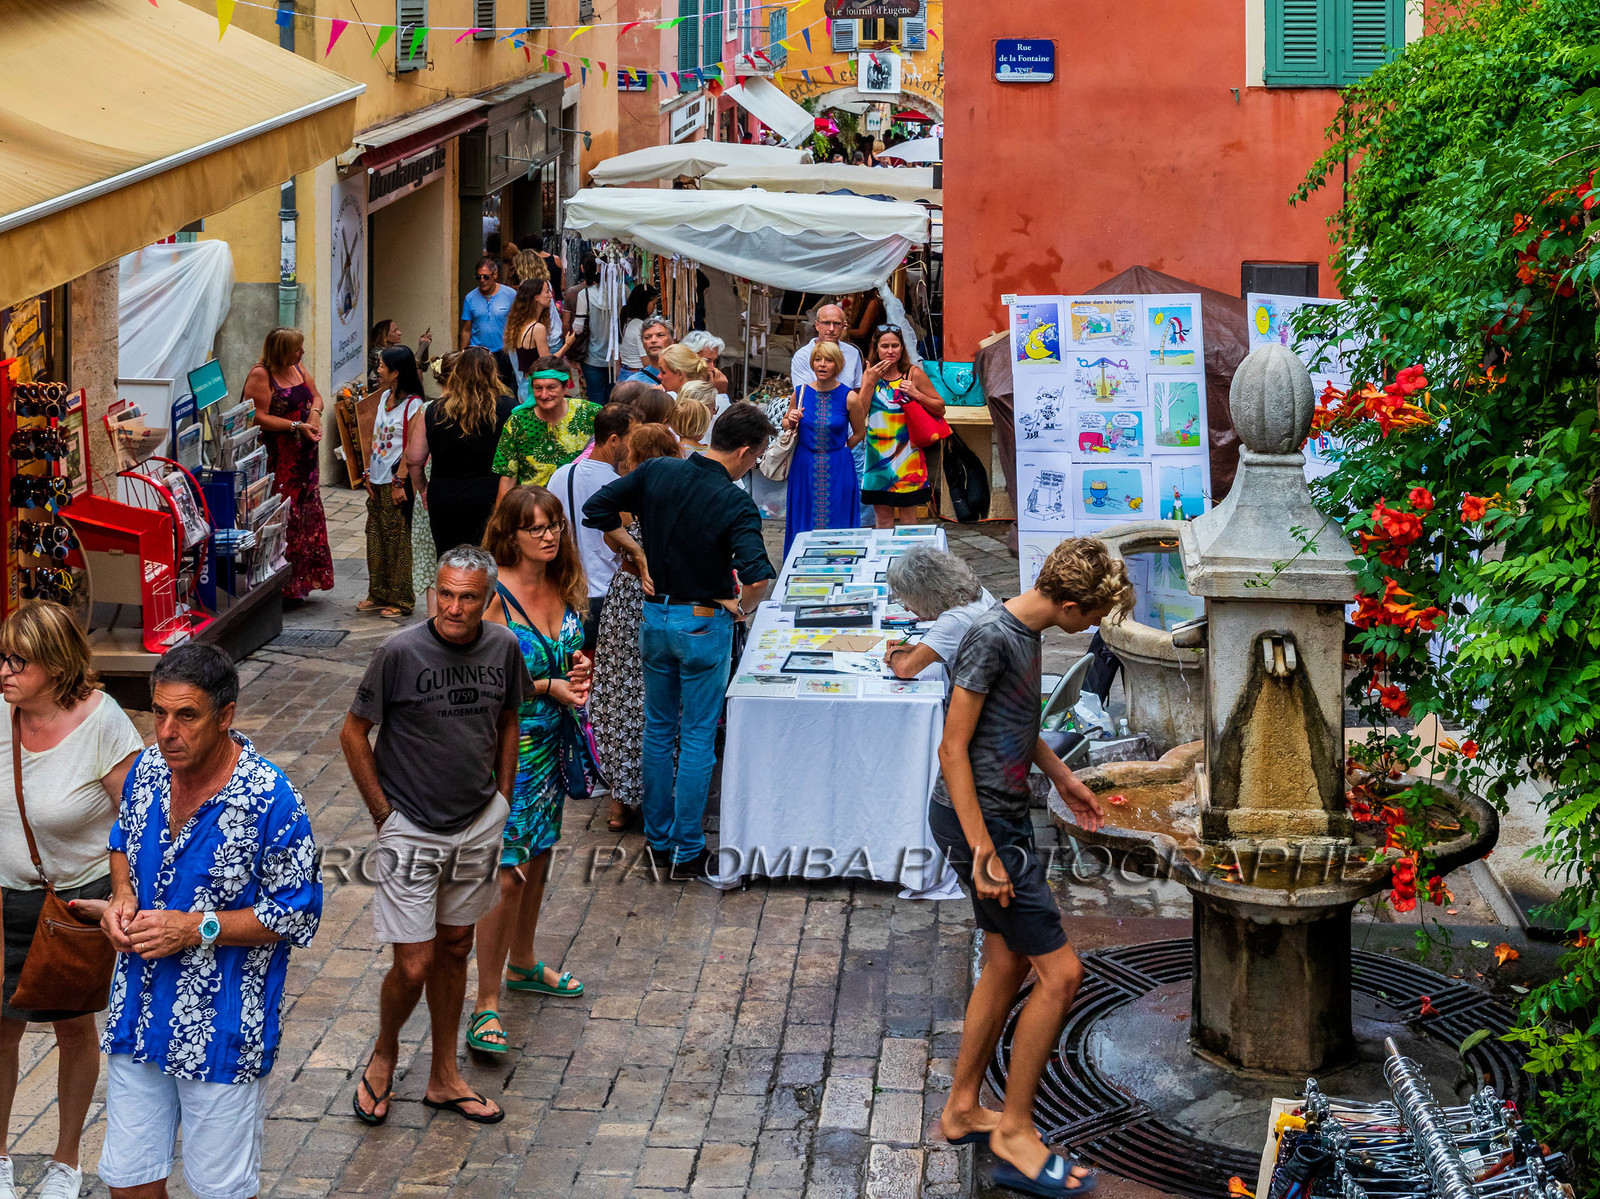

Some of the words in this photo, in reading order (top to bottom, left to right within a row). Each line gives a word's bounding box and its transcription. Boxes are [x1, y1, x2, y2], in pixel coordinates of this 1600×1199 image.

[846, 5, 873, 16] fournil
[875, 4, 912, 18] d'Eugène
[1016, 43, 1032, 51] Rue
[998, 54, 1008, 62] de
[1009, 54, 1016, 62] la
[1018, 54, 1050, 62] Fontaine
[368, 145, 446, 204] Boulangerie
[415, 665, 505, 695] GUINNESS
[450, 690, 475, 701] 1759
[437, 706, 490, 718] TRADEMARK
